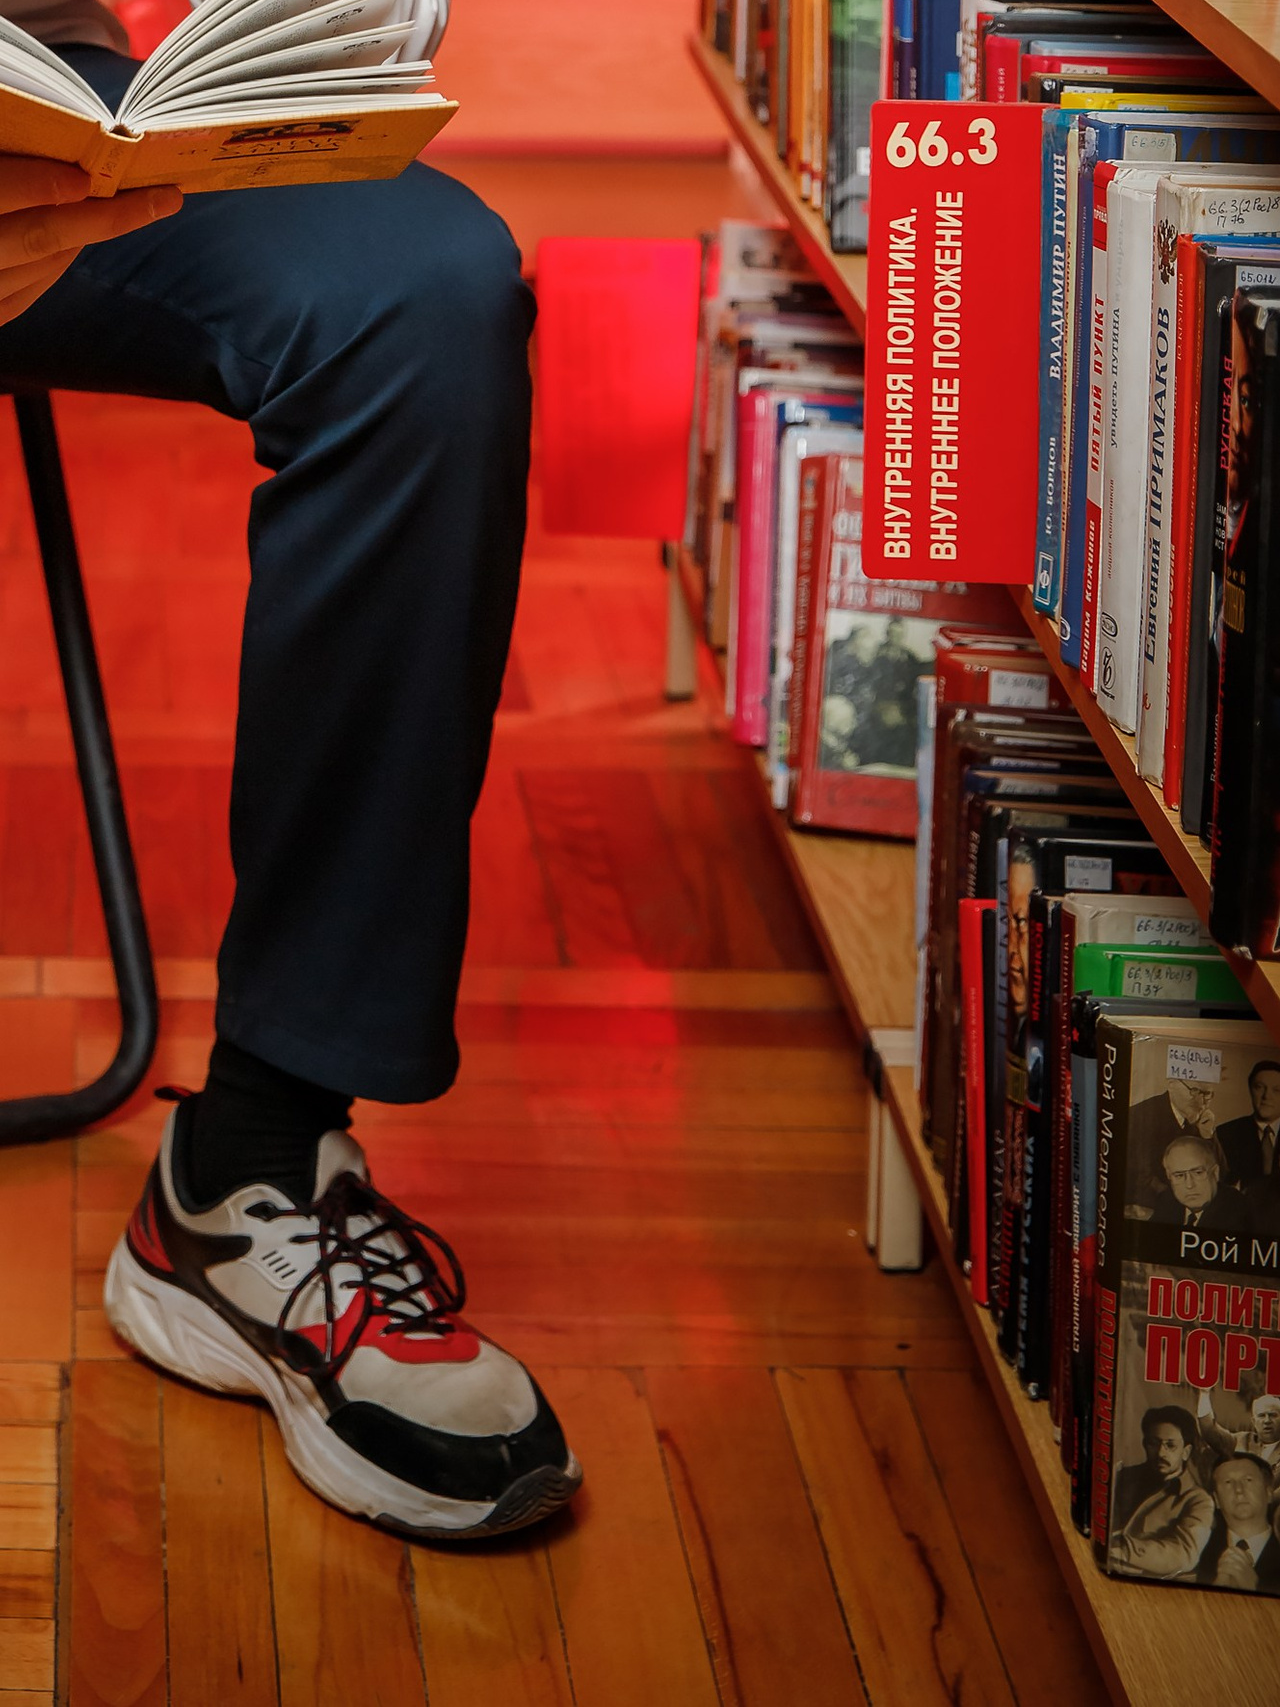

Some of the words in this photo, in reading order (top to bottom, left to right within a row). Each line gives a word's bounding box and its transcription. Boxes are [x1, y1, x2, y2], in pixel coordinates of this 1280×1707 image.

[885, 117, 999, 168] 66.3
[1053, 153, 1067, 238] ПУТИН
[886, 207, 918, 365] ПОЛИТИКА.
[932, 190, 964, 369] ПОЛОЖЕНИЕ
[1049, 244, 1066, 380] ВЛАДИМИР
[1093, 293, 1105, 376] ПУНКТ
[1110, 307, 1121, 377] ПУТИНА
[1090, 386, 1102, 472] ПЯТЫЙ
[1109, 381, 1118, 449] увидеть
[1148, 306, 1170, 530] ПРИМАКОВ
[1220, 355, 1234, 471] РУССКАЯ
[883, 374, 914, 560] ВНУТРЕННЯЯ
[929, 377, 961, 561] ВНУТРЕННЕЕ
[1046, 436, 1057, 505] БОРЦОВ
[1083, 519, 1095, 603] Кожинов
[1144, 536, 1162, 665] Евгений
[1080, 611, 1091, 673] Вадим
[967, 830, 980, 898] ЕВГЕНИ
[1029, 922, 1044, 1021] ЯМЩИКОВ
[1099, 1042, 1118, 1101] Рой
[1071, 1102, 1081, 1170] ЛУБЯНКИ
[1019, 1136, 1035, 1255] РУССКИХ
[1071, 1185, 1081, 1255] ФАВОРИТ
[1096, 1108, 1115, 1267] Медведев
[1180, 1231, 1238, 1264] Рой
[1071, 1256, 1081, 1353] СТАЛИНСКИЙ
[1147, 1276, 1280, 1330] ПОЛИТ
[1092, 1286, 1118, 1546] ПОЛИТИЧЕСКИЕ
